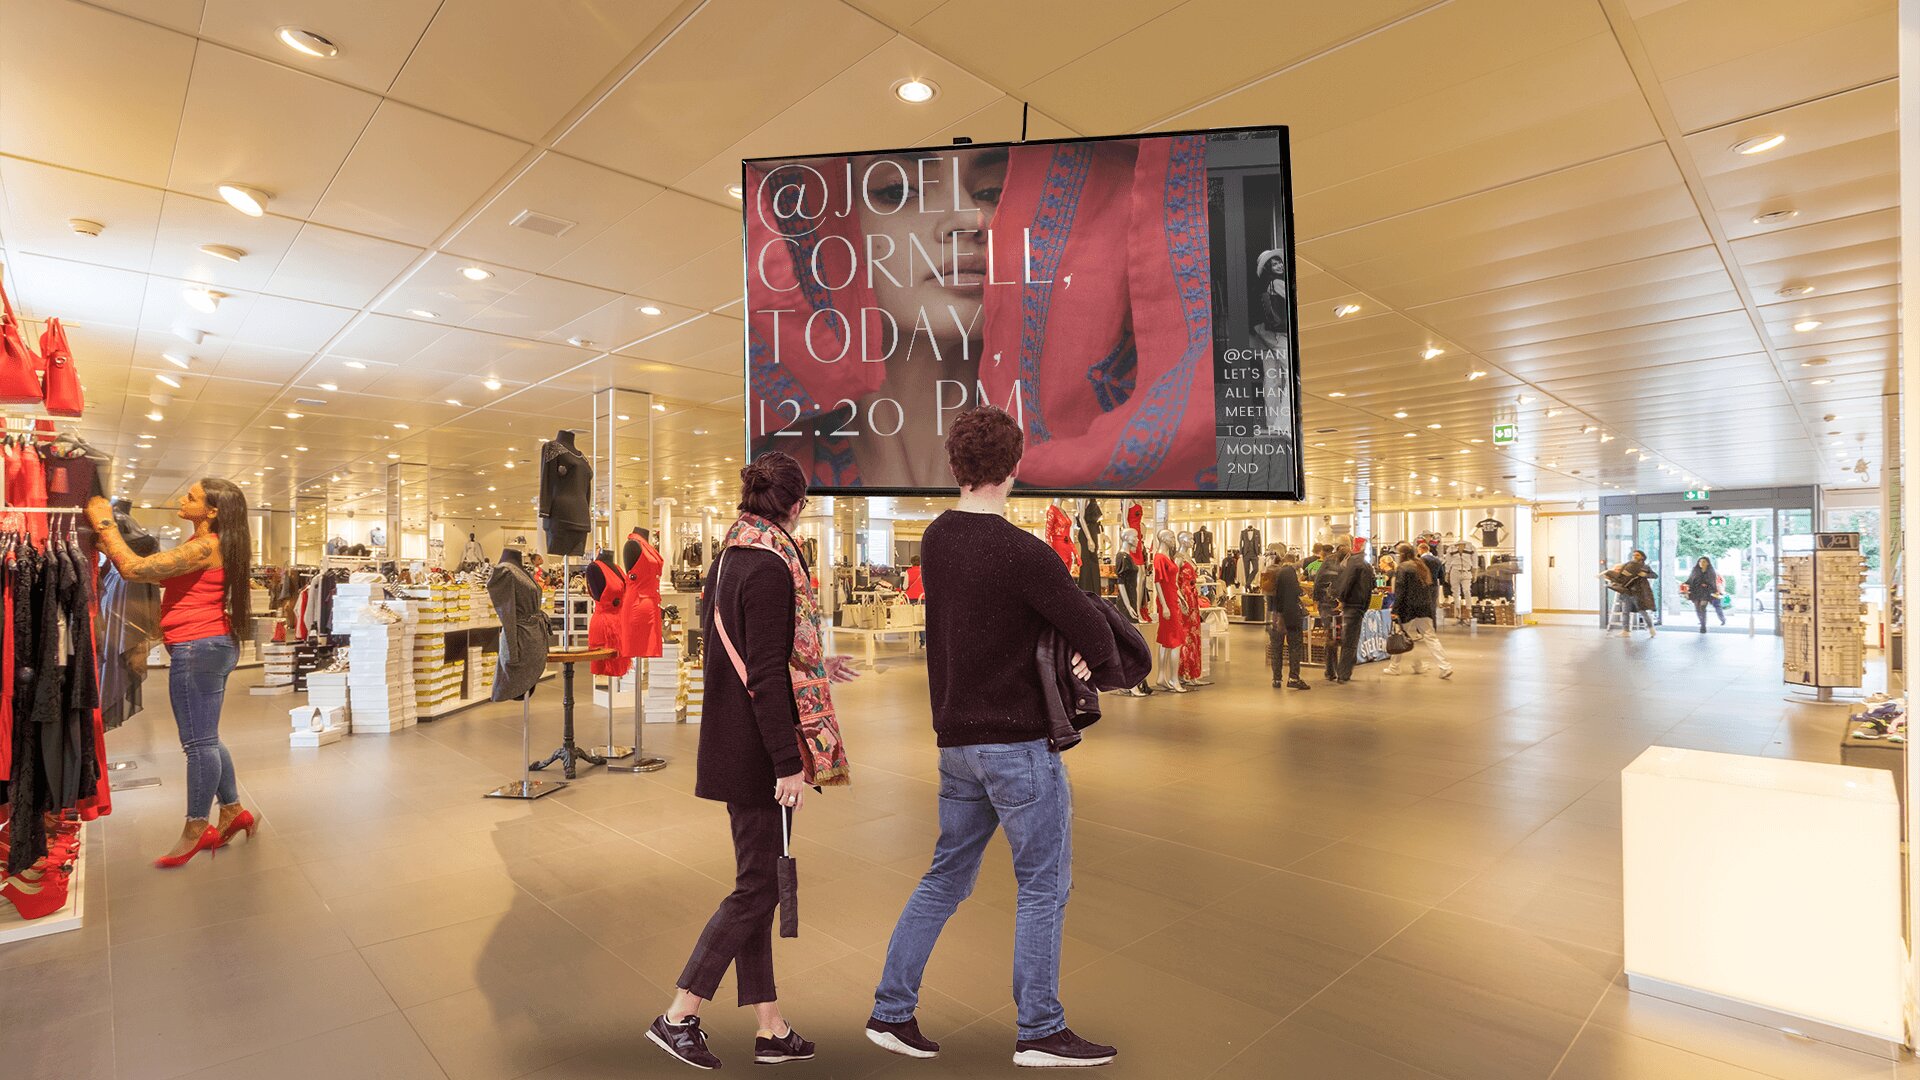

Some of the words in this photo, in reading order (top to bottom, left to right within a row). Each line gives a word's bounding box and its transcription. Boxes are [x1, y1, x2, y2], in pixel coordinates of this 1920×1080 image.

[757, 156, 981, 237] @JOEL
[758, 228, 1073, 292] CORNELL,
[757, 304, 1003, 367] TODAY,
[1224, 368, 1260, 380] LET'S
[1225, 387, 1251, 398] ALL
[760, 398, 904, 436] 12:20
[1225, 405, 1291, 417] MEETING
[1226, 425, 1247, 436] TO
[1253, 424, 1262, 436] 3
[1268, 425, 1290, 437] PM
[1226, 443, 1293, 456] MONDAY
[1227, 462, 1259, 474] 2ND
